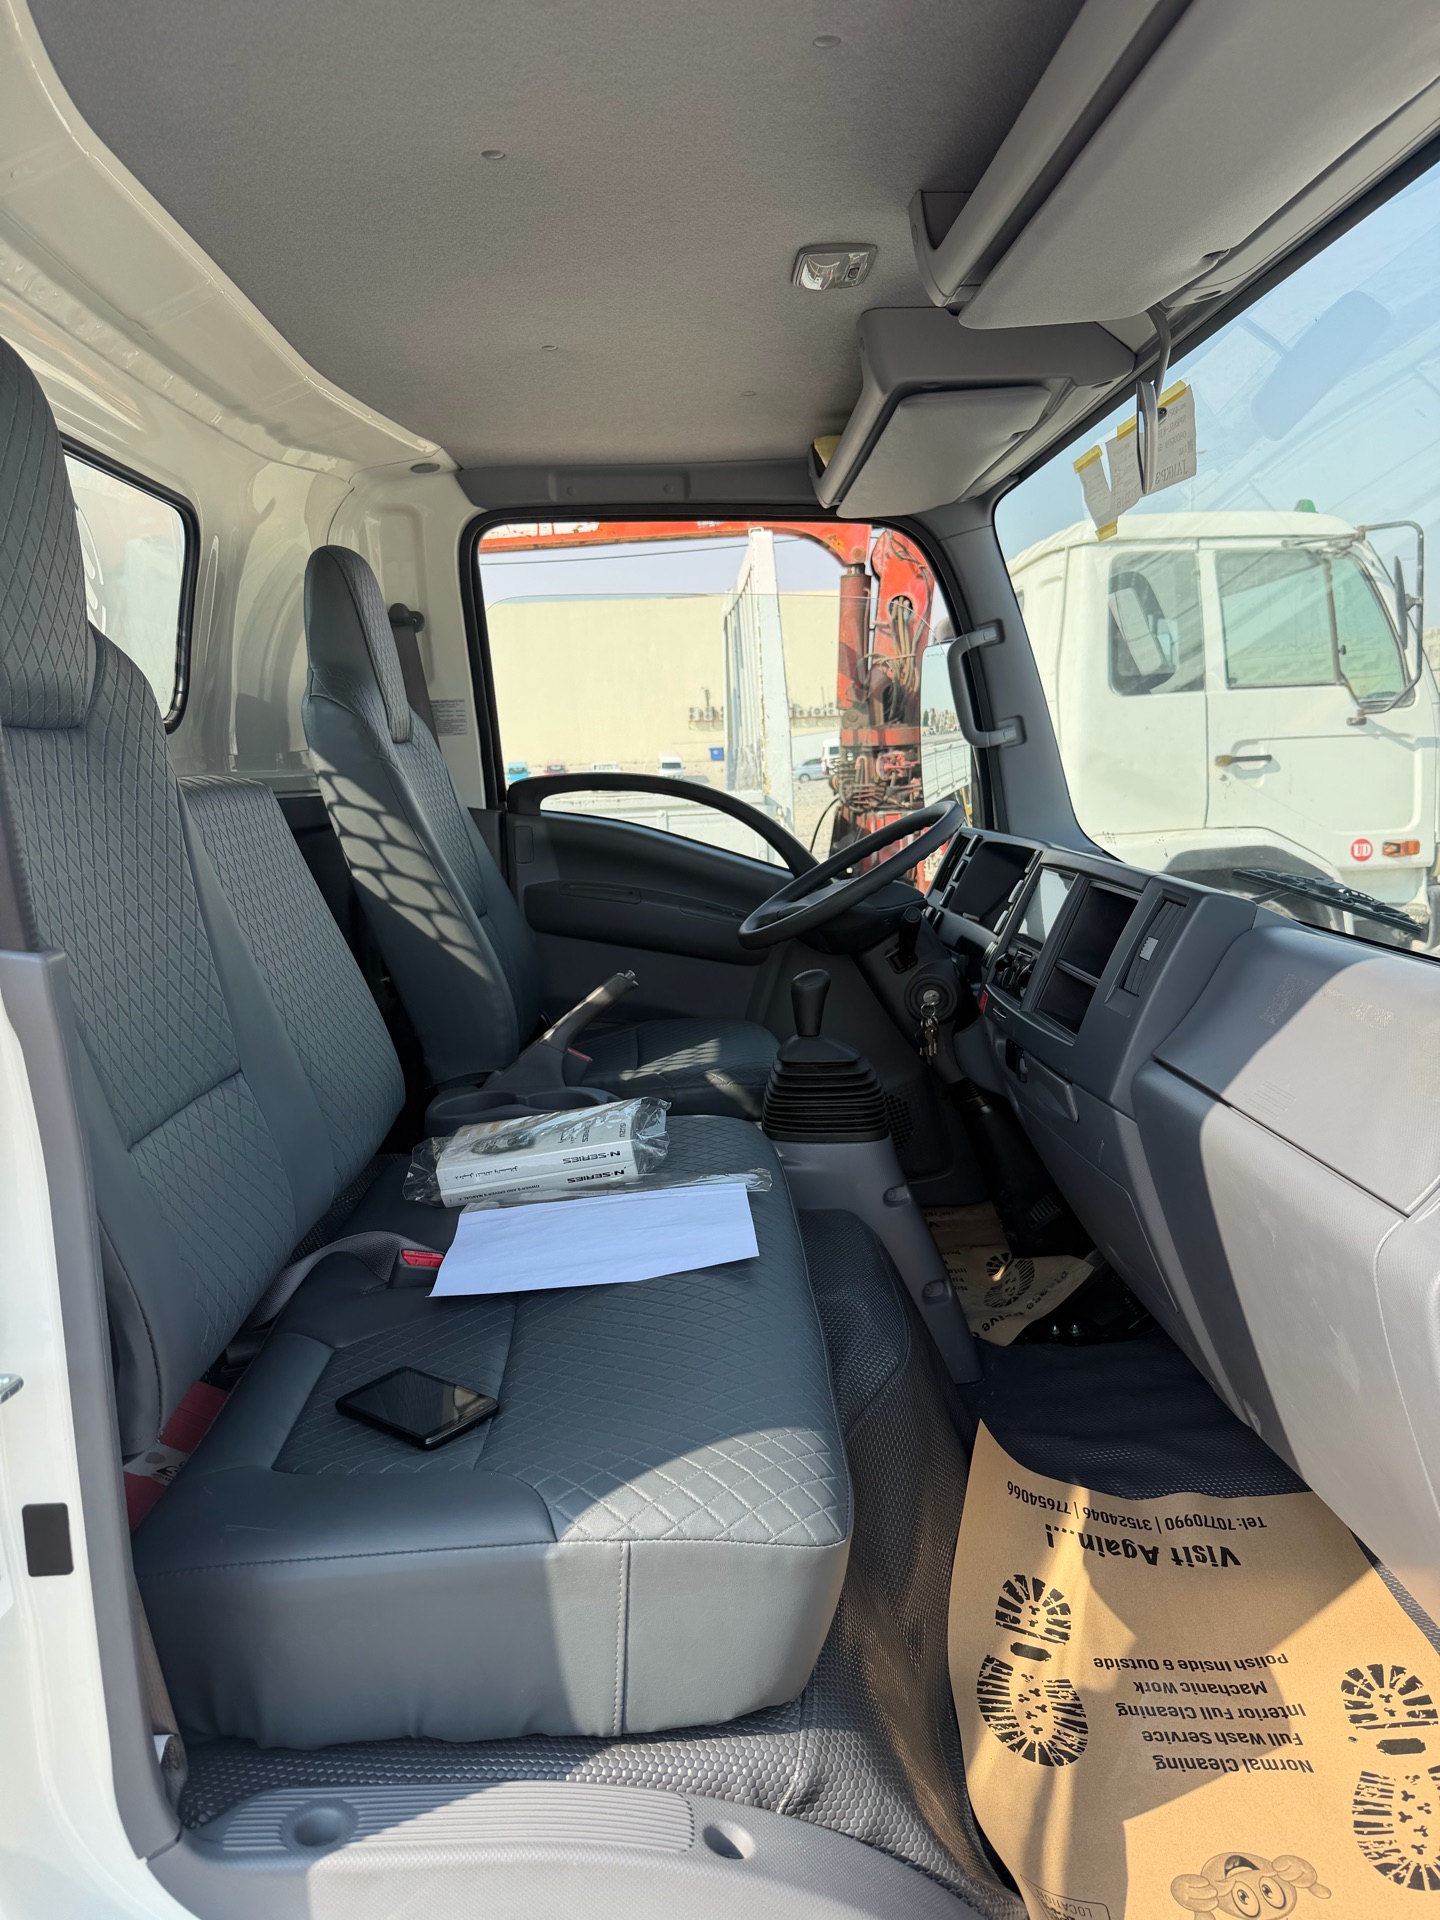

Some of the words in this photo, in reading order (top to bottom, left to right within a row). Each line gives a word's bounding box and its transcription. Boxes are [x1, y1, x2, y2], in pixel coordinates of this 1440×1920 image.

[1354, 843, 1371, 857] UD
[1006, 1480, 1071, 1515] 77654066
[1082, 1506, 1151, 1531] 31524046
[1164, 1512, 1236, 1532] 70770990
[1236, 1514, 1266, 1529] Tel:
[1170, 1544, 1241, 1567] Visit
[1093, 1657, 1160, 1672] Outside
[1162, 1657, 1174, 1672] &
[1177, 1656, 1232, 1673] Inside
[1234, 1652, 1288, 1672] Polish
[1132, 1680, 1178, 1696] Work
[1181, 1680, 1268, 1696] Machanic
[1115, 1702, 1197, 1721] Cleaning
[1198, 1706, 1234, 1721] Full
[1237, 1703, 1307, 1720] Interior
[1141, 1730, 1212, 1746] Service
[1214, 1731, 1266, 1746] Wash
[1268, 1731, 1303, 1747] Full
[1152, 1755, 1240, 1774] Cleaning
[1241, 1757, 1314, 1774] Normal
